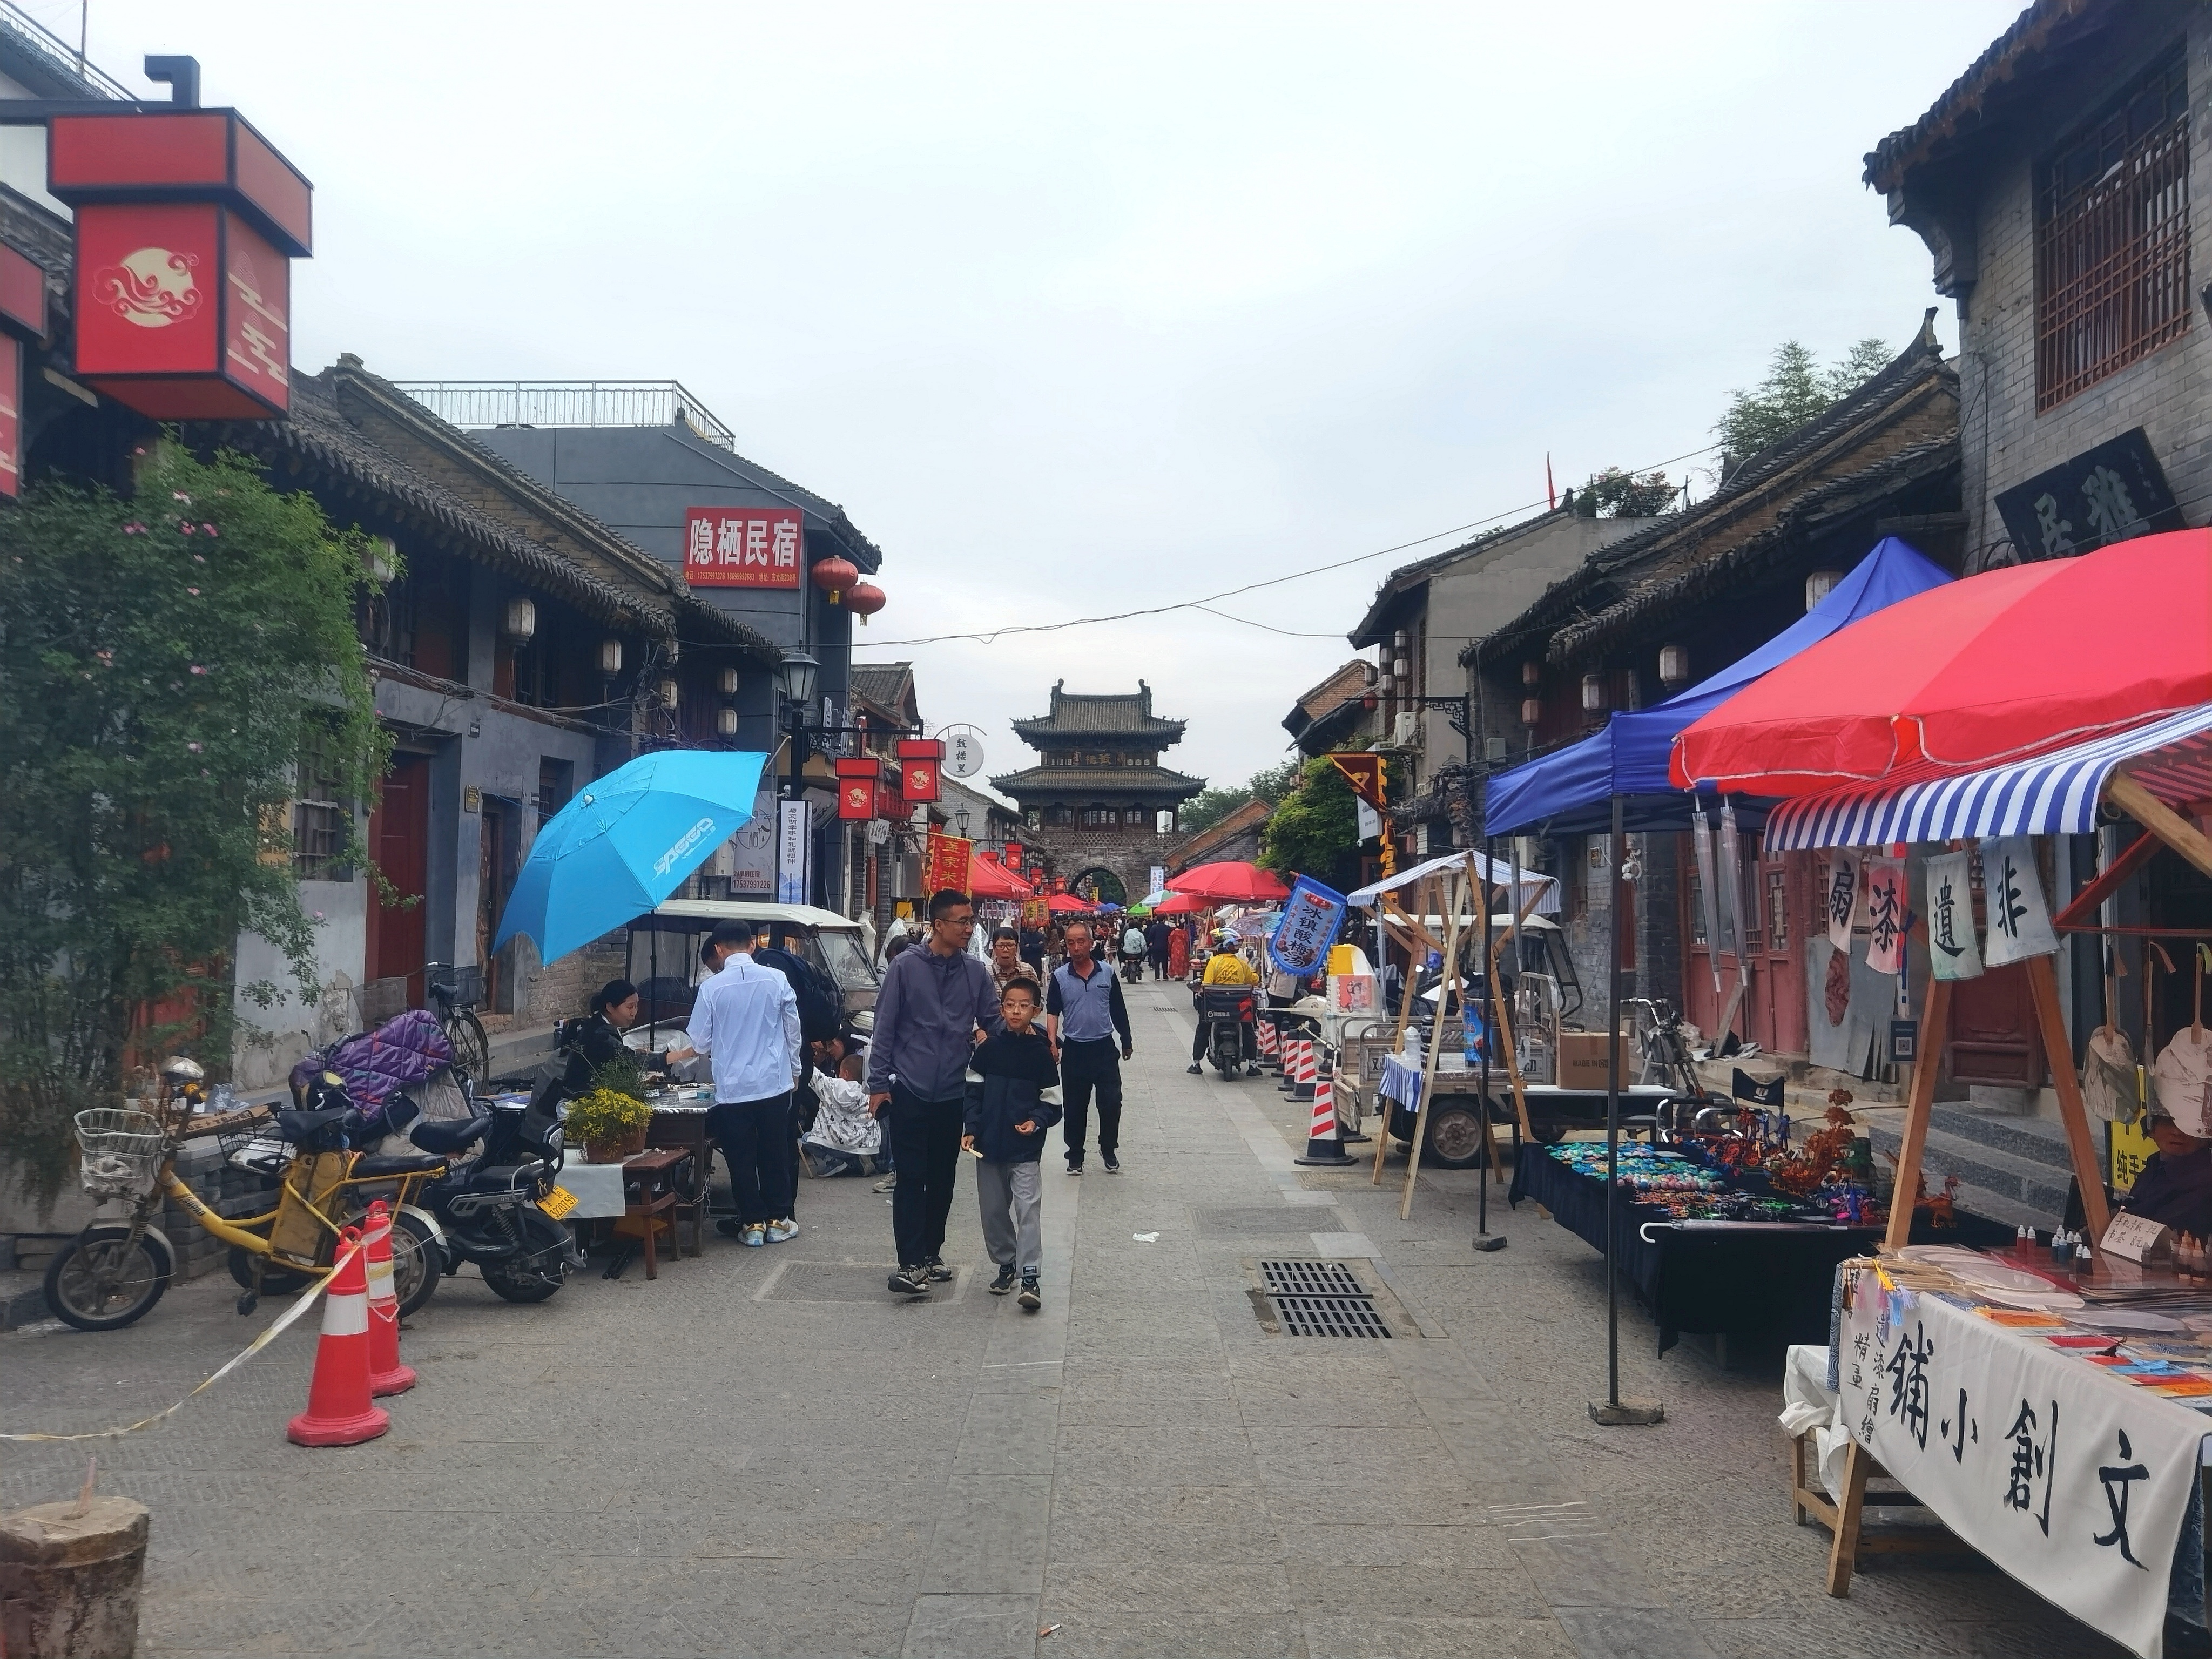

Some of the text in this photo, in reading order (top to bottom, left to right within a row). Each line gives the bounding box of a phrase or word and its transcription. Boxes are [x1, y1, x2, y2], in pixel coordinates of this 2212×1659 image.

[689, 517, 798, 567] 隐栖民宿
[698, 571, 725, 580] 17537997226
[956, 738, 967, 773] 鼓楼里
[787, 808, 797, 864] 与文明牵手和礼貌相伴
[733, 880, 771, 889] 17537997226
[940, 841, 961, 892] 孟家米
[1828, 860, 1855, 927] 扇
[1870, 878, 1899, 953] 漆
[1997, 855, 2027, 939] 非
[1284, 905, 1323, 968] 冰镇酸梅汤
[2117, 1149, 2148, 1184] 纯手
[549, 1195, 576, 1218] 3220759
[2107, 1228, 2127, 1243] 书签
